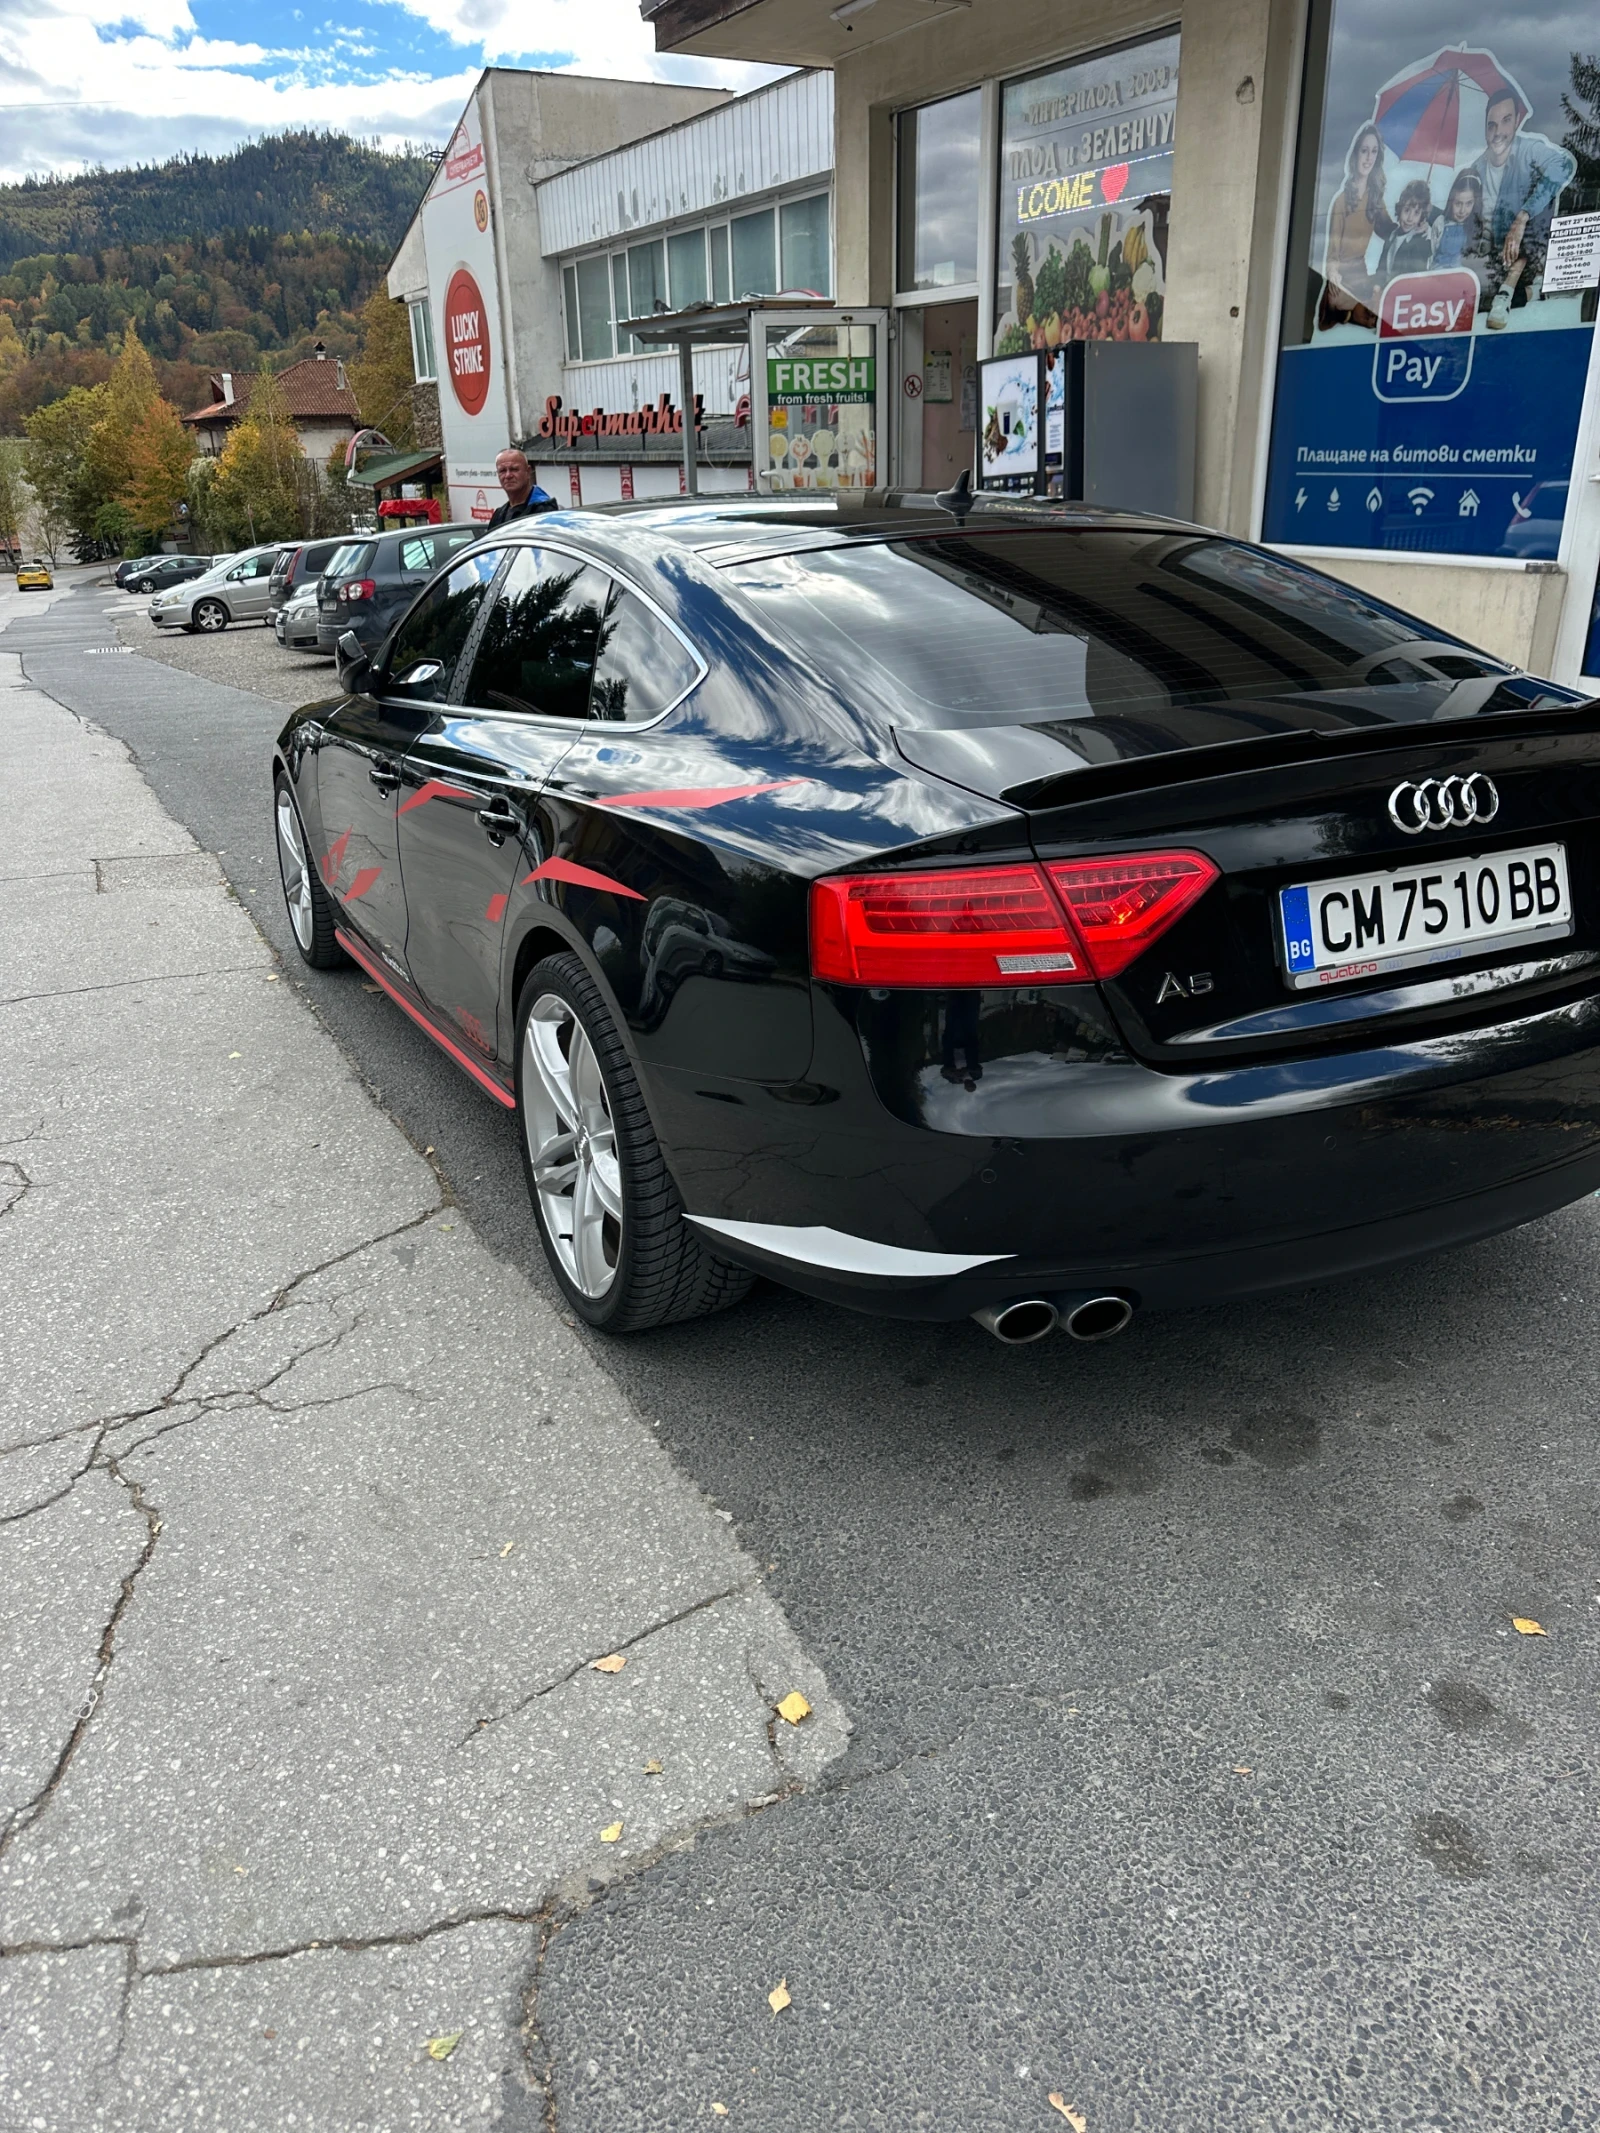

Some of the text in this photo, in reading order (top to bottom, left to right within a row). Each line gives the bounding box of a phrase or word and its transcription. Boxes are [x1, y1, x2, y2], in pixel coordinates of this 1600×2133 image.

[1010, 142, 1062, 181] ПЛОД
[1080, 111, 1176, 163] ЗЕЛЕНЧУ
[1551, 227, 1582, 238] РАБОТНО
[451, 310, 479, 343] LUCKY
[1392, 294, 1465, 332] Easy
[453, 344, 484, 376] STRIKE
[1387, 349, 1442, 389] Pay
[775, 362, 868, 391] FRESH
[777, 392, 867, 405] from fresh fruits!
[1297, 444, 1536, 464] Плащане на битови сметки
[1289, 939, 1311, 960] BG
[1319, 948, 1462, 984] quattro Audi
[1155, 971, 1215, 1005] A5
